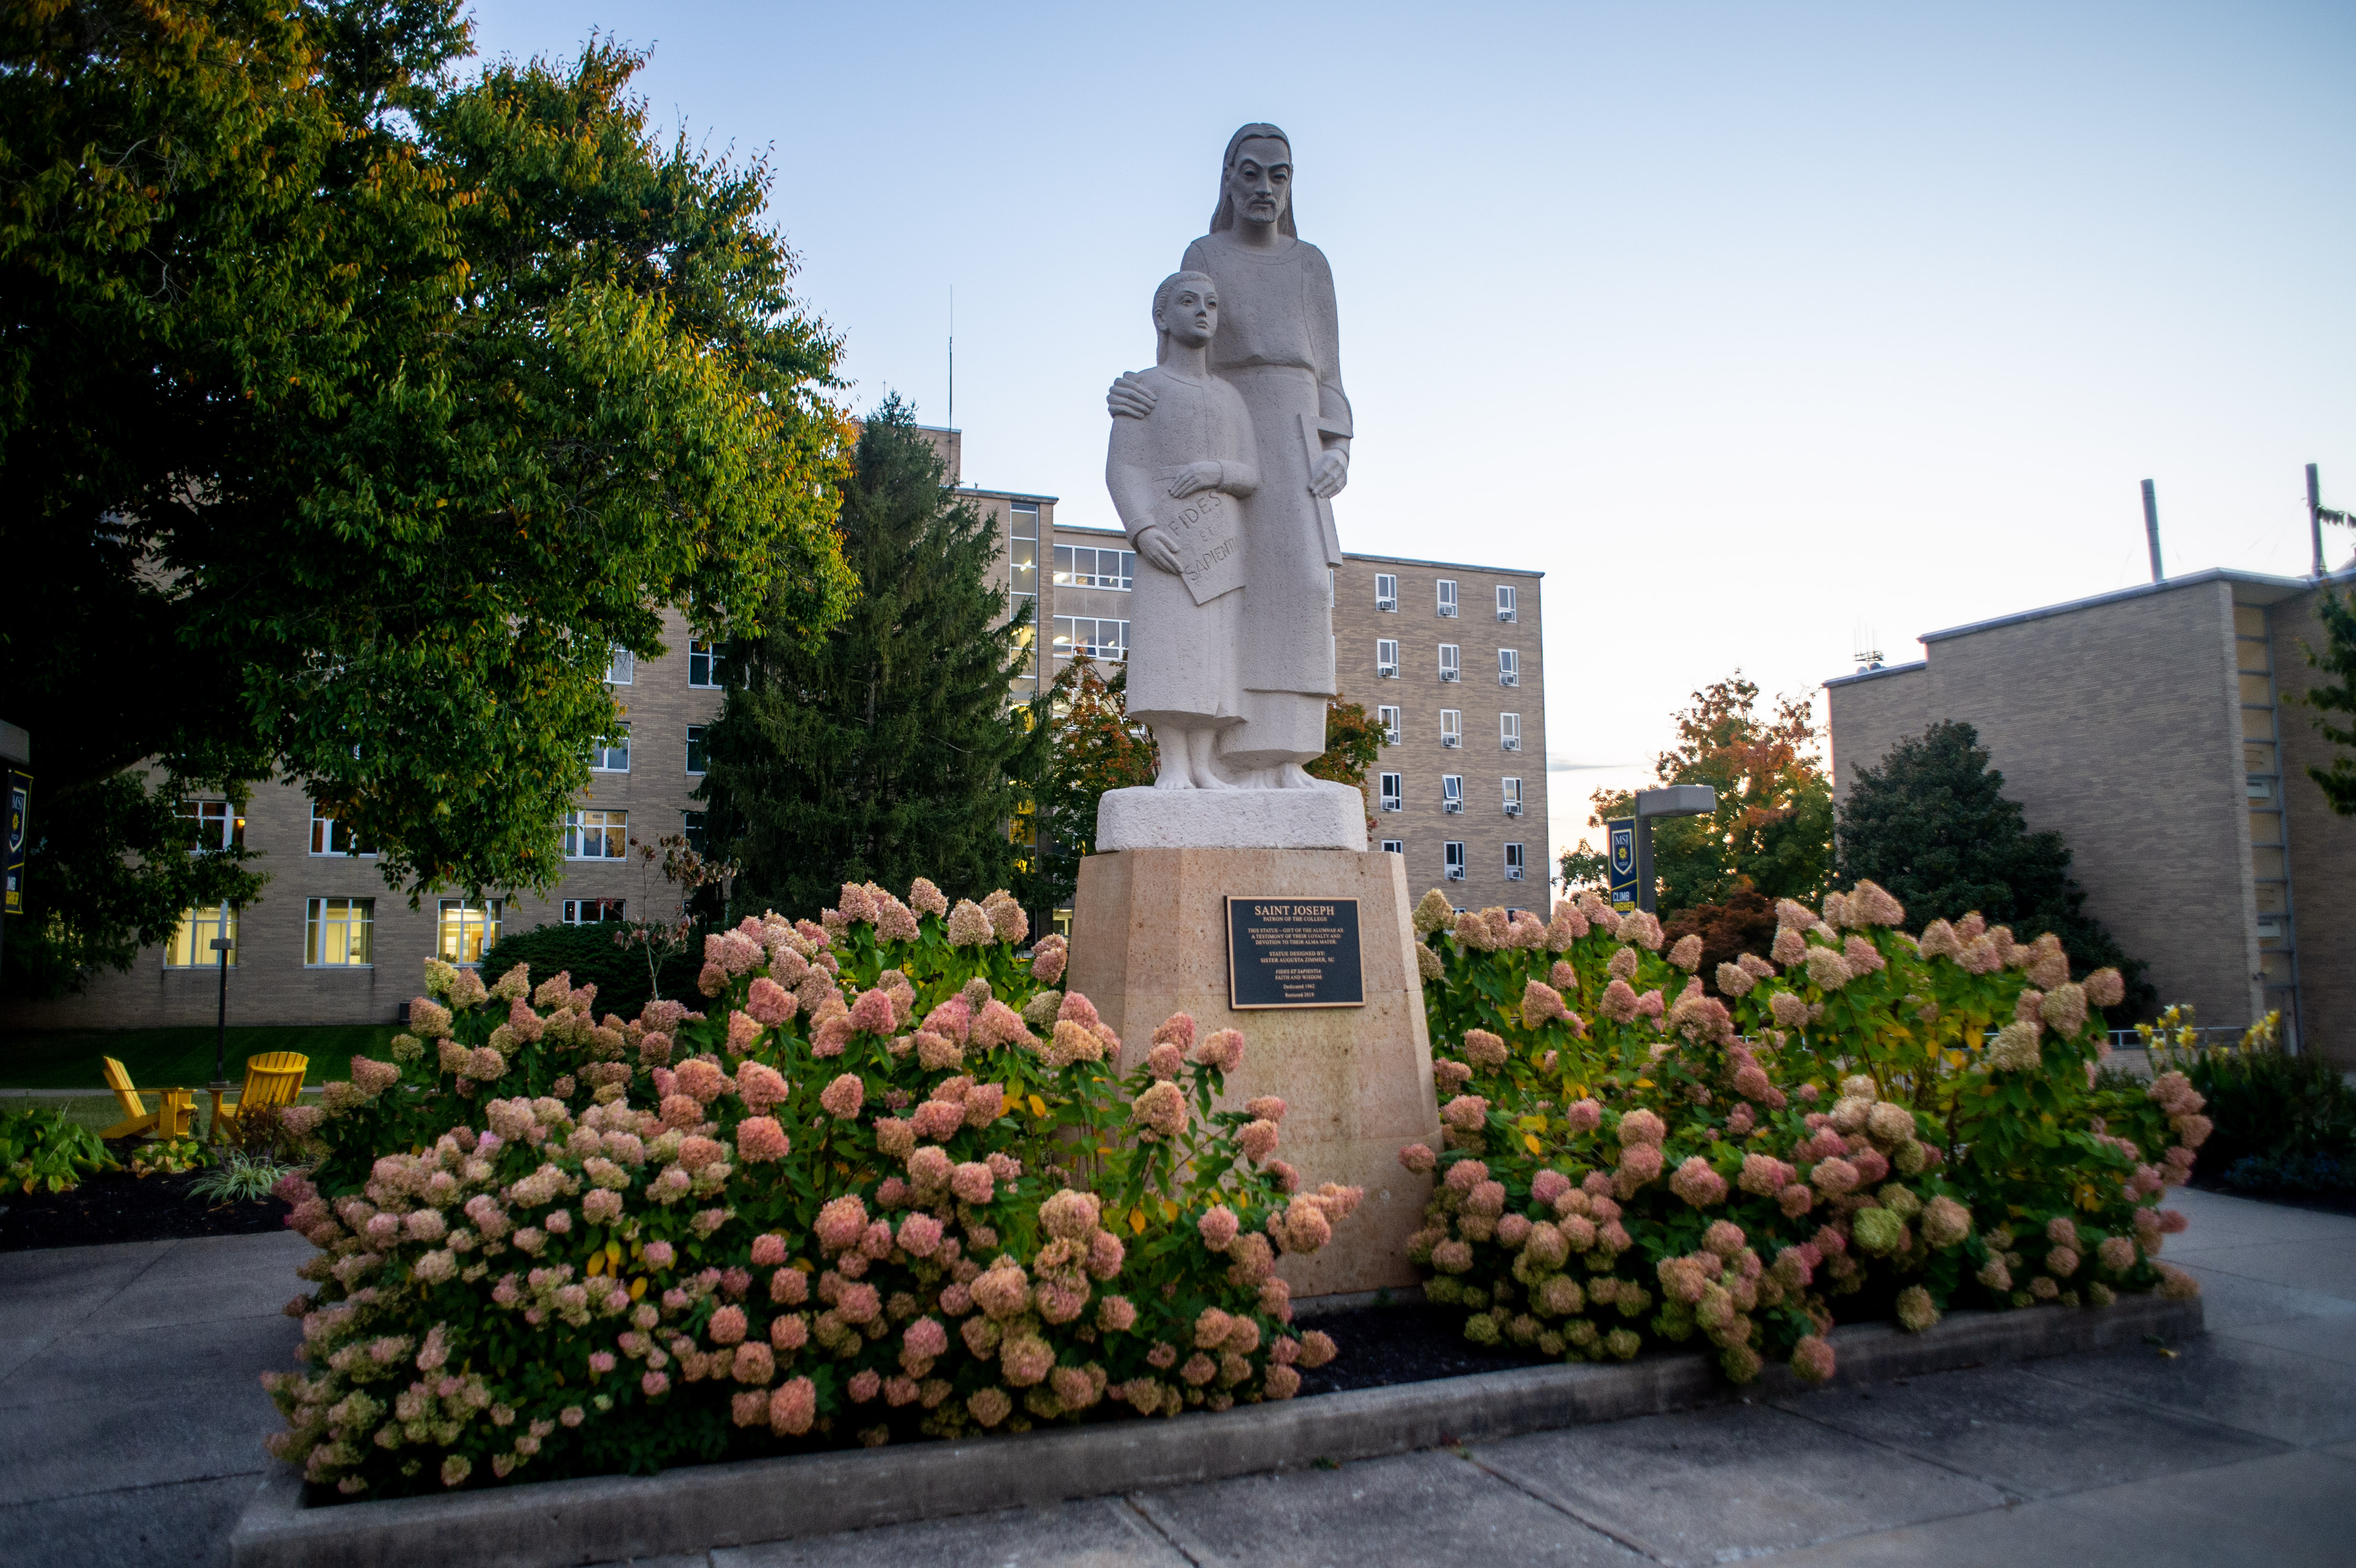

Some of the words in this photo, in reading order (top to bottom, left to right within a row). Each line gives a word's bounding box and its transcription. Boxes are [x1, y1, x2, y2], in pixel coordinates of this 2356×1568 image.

[1168, 490, 1221, 536] FIDES
[1200, 526, 1214, 542] ET
[1614, 834, 1628, 847] MSJ
[1613, 891, 1629, 902] CLIMB
[1254, 905, 1290, 915] SAINT
[1293, 905, 1334, 915] JOSEPH
[1613, 901, 1635, 911] HIGHER
